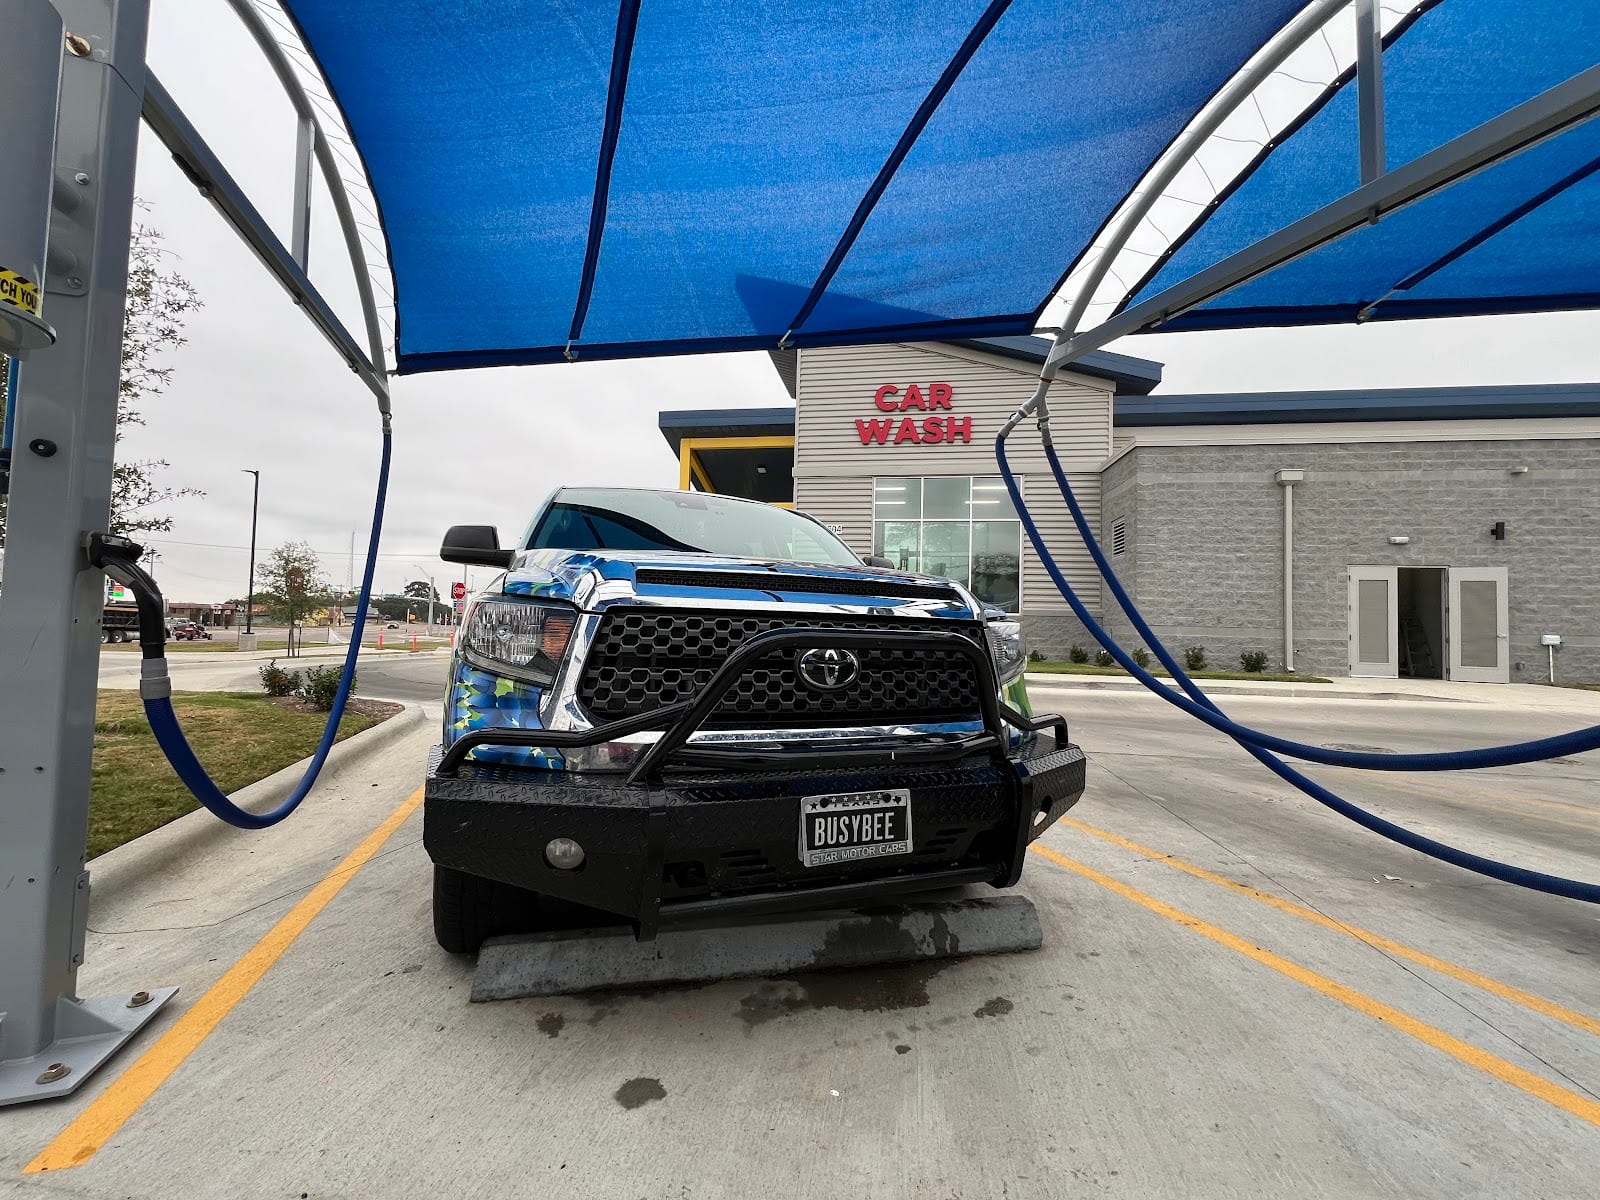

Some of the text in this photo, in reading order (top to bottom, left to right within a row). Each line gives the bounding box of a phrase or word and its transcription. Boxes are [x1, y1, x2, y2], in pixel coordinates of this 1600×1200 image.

[0, 278, 17, 299] CH
[874, 383, 953, 412] CAR
[855, 416, 972, 445] WASH
[453, 587, 465, 595] STOP
[815, 812, 895, 847] BUSYBEE
[811, 842, 906, 864] STAR MOTOR CARS
